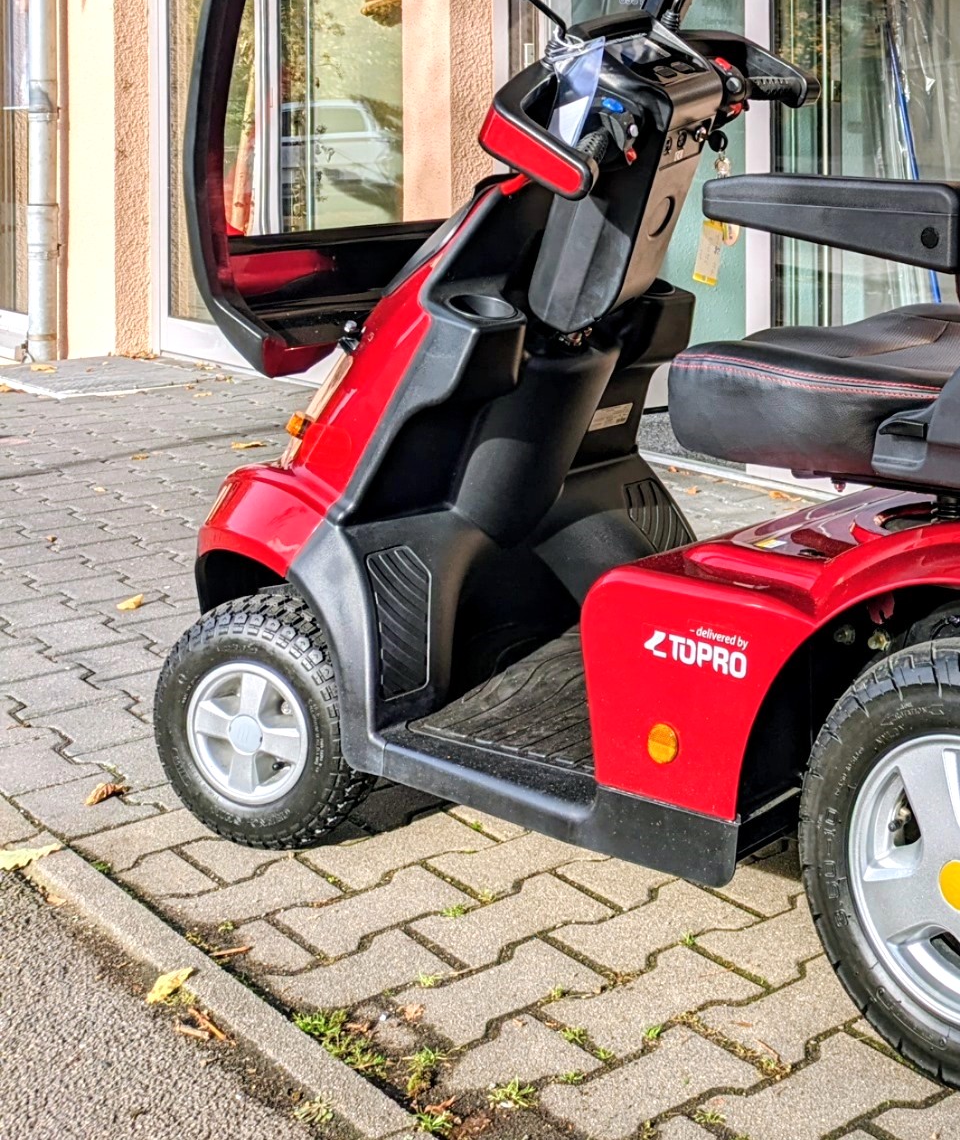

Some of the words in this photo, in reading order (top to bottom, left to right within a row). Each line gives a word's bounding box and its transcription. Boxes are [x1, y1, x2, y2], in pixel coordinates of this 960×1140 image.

[696, 626, 737, 646] delivered
[737, 635, 749, 651] by
[669, 634, 748, 679] TOPRO
